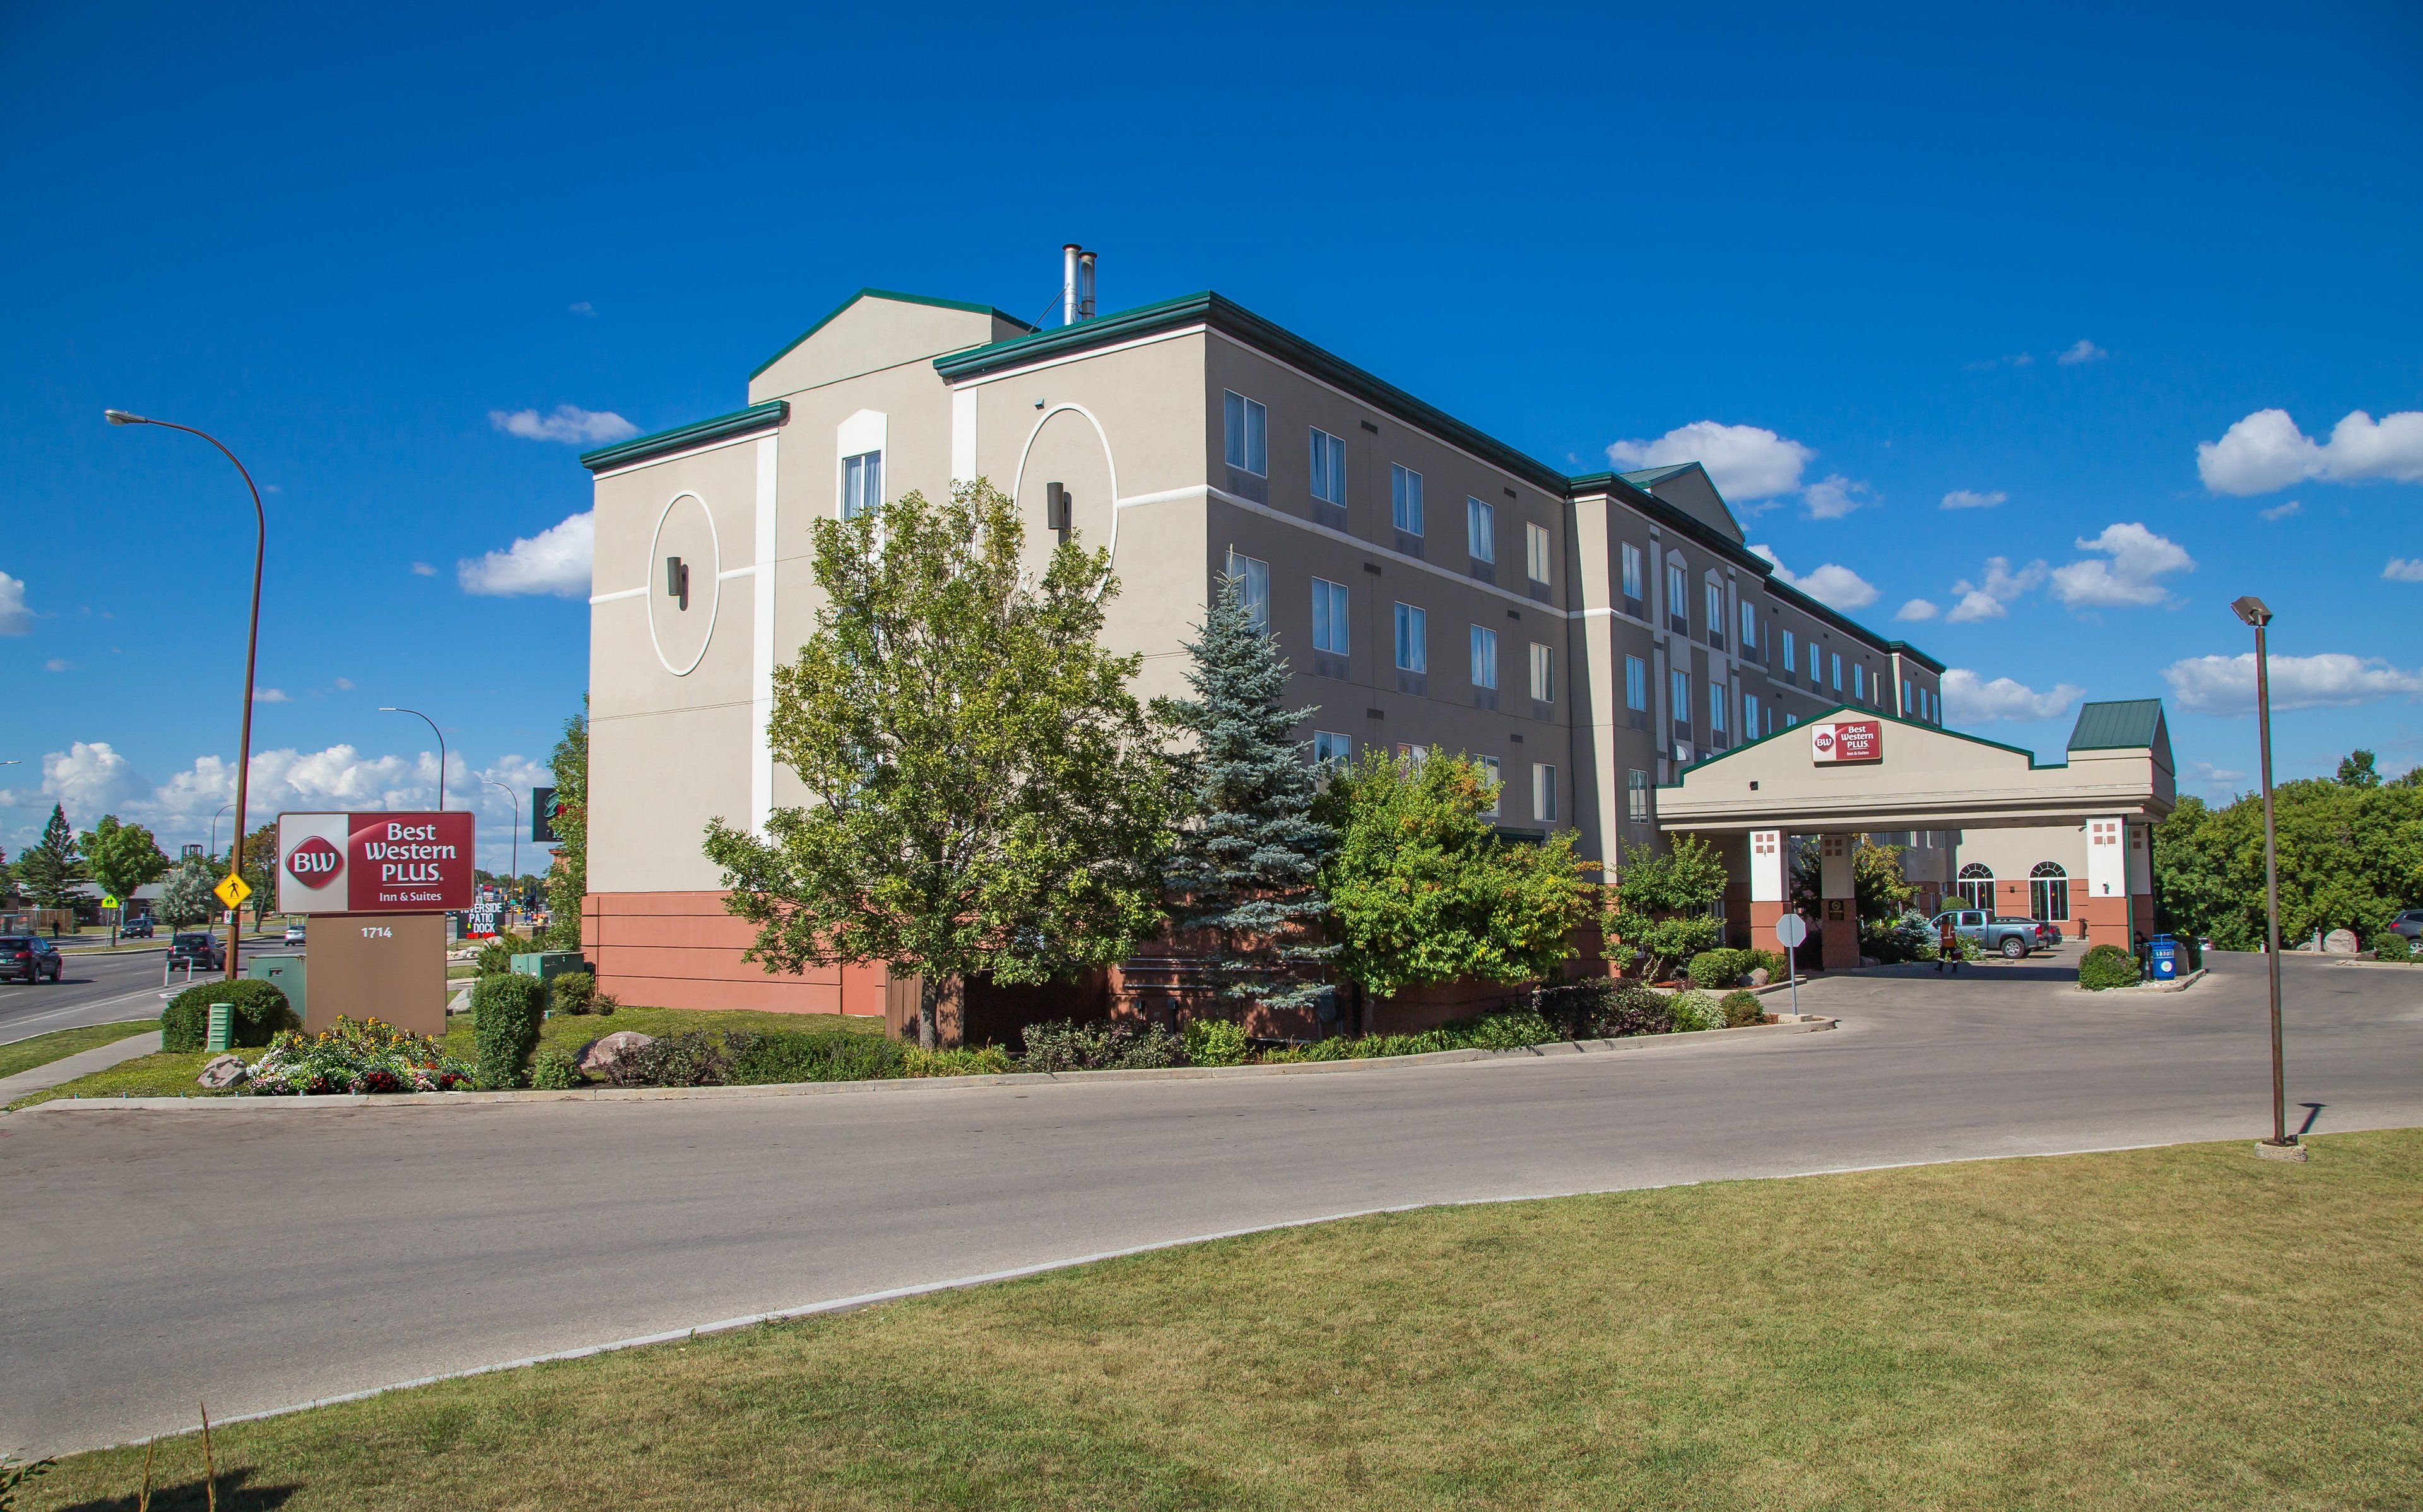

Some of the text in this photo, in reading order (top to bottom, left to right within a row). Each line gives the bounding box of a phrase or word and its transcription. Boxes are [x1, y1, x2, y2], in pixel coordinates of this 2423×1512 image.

[1817, 738, 1832, 747] BW
[387, 823, 437, 841] Best
[365, 842, 456, 860] Western
[294, 852, 336, 873] BW
[379, 891, 442, 901] Inn & Suites
[461, 903, 502, 913] VERSIDE
[469, 913, 494, 923] PATIO
[361, 927, 392, 939] 1714
[473, 923, 496, 933] DOCK
